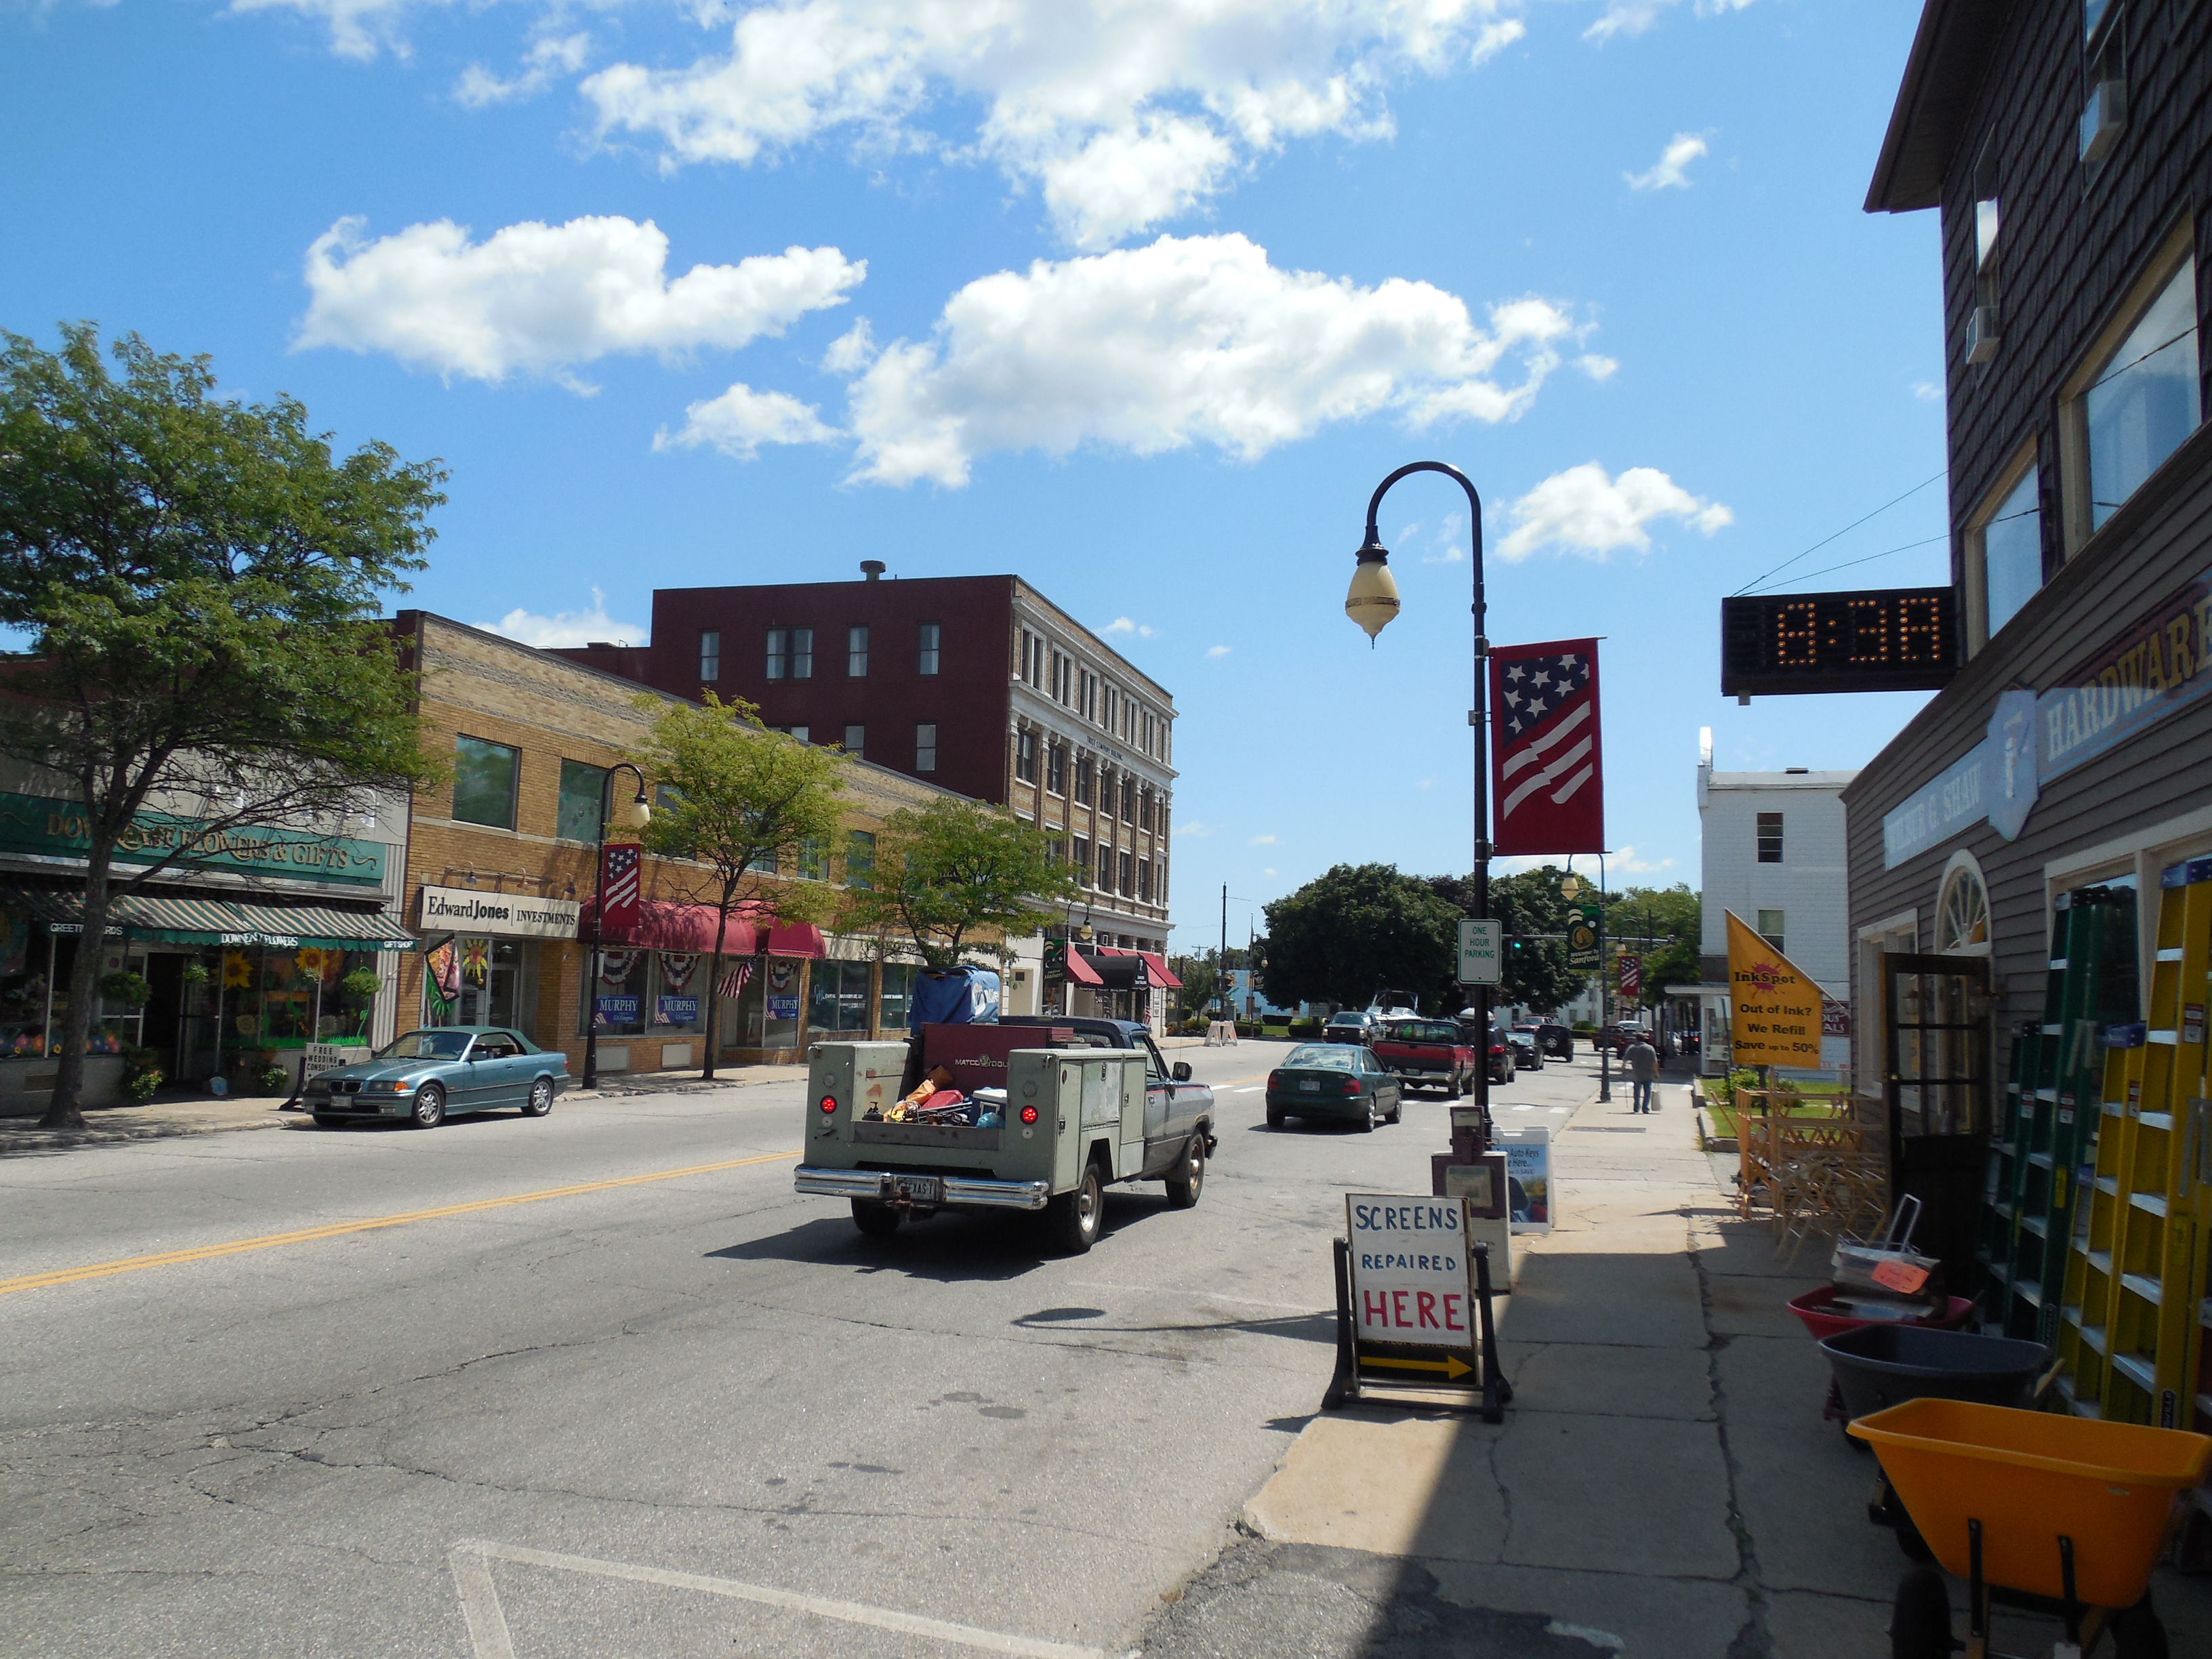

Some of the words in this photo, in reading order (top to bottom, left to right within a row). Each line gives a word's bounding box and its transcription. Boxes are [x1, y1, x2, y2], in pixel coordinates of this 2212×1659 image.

[274, 840, 287, 862] &
[292, 845, 348, 868] GIFTS
[516, 909, 575, 926] INVESTMENTS
[1473, 926, 1487, 935] ONE
[264, 935, 298, 947] FLOWERS
[398, 941, 413, 949] SHOP
[1470, 939, 1490, 947] HOUR
[1465, 950, 1494, 958] PARKING
[1569, 954, 1600, 965] Sanford
[599, 1000, 638, 1011] MURPHY
[663, 1000, 697, 1011] MURPHY
[771, 999, 798, 1009] MURPHY
[1740, 1004, 1763, 1013] Out
[1767, 1005, 1780, 1014] of
[1784, 1006, 1812, 1016] Ink?
[1747, 1023, 1767, 1033] We
[1772, 1024, 1805, 1036] Refill
[313, 1046, 333, 1054] FREE
[1735, 1040, 1765, 1050] Save
[1793, 1042, 1820, 1054] 50%
[308, 1054, 337, 1064] WEDDING
[1510, 1148, 1524, 1158] Auto
[1525, 1148, 1539, 1160] Keys
[1355, 1205, 1458, 1231] SCREENS
[1362, 1254, 1456, 1271] REPAIRED
[1364, 1290, 1465, 1331] HERE
